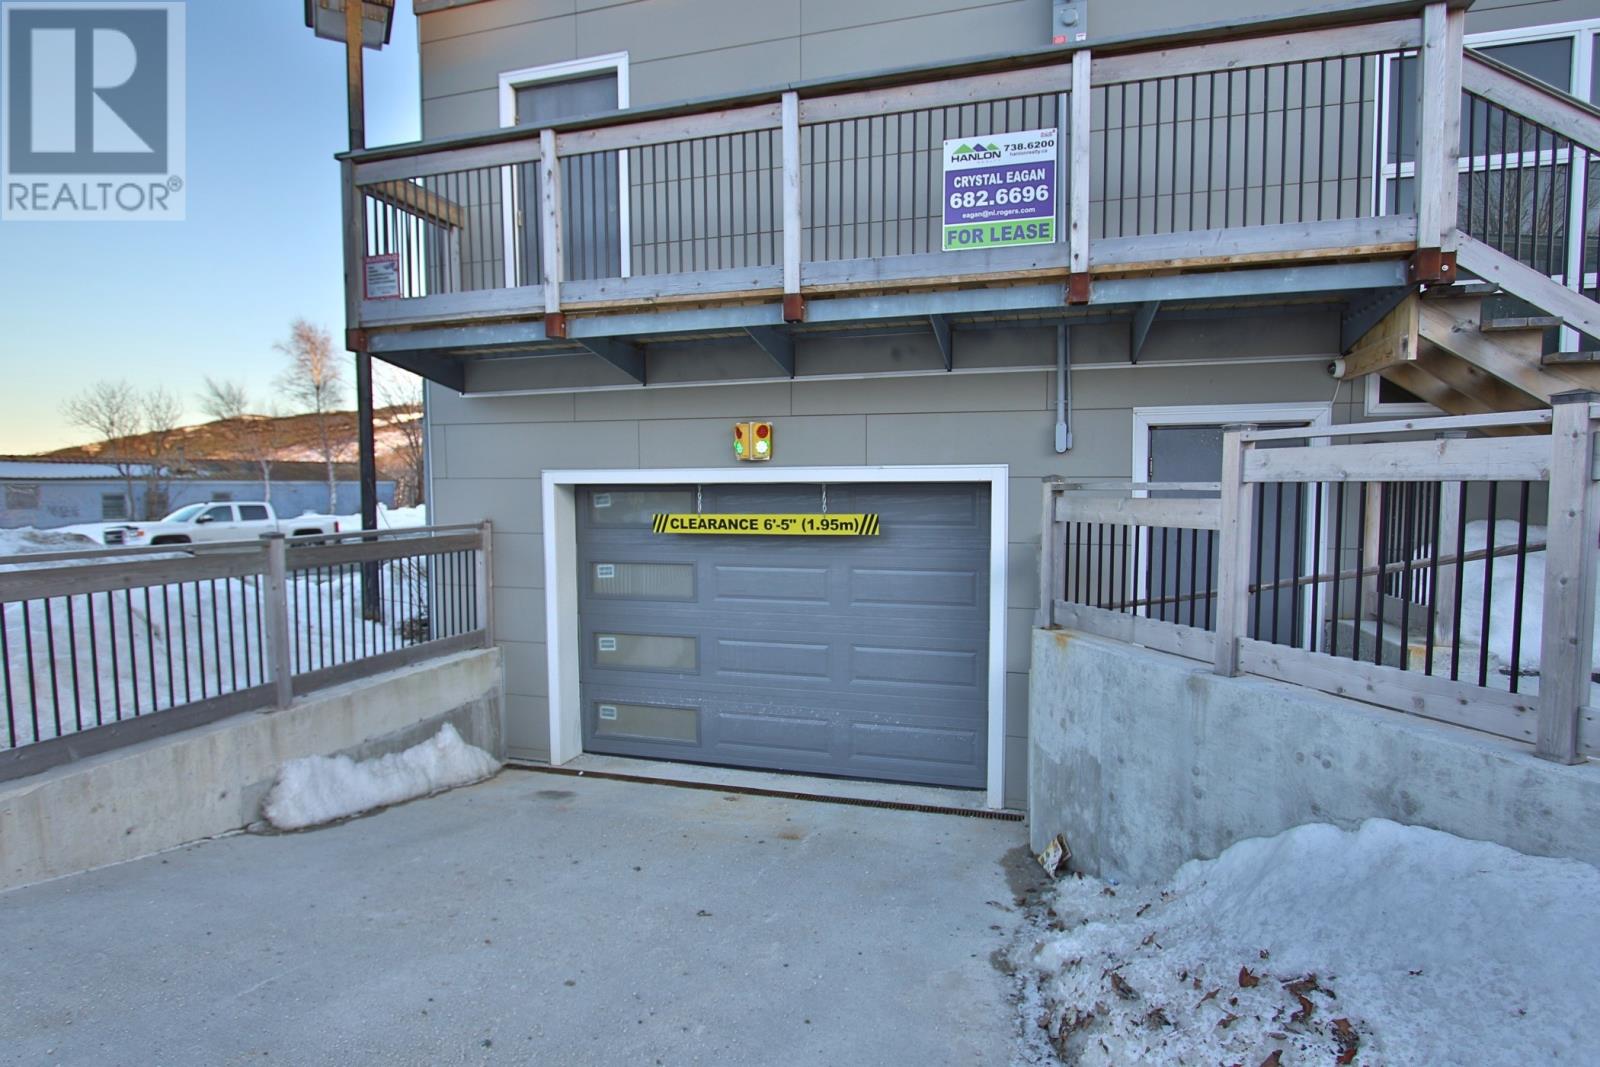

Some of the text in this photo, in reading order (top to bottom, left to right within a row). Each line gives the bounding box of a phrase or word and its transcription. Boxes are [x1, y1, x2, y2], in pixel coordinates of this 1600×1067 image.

[1004, 139, 1055, 152] 738.6200
[951, 151, 1002, 163] HANLON
[953, 168, 1046, 187] CRYSTAL EAGAN
[949, 184, 1049, 209] 682.6696
[946, 222, 1050, 246] FOR LEASE
[669, 517, 759, 531] CLEARANCE
[801, 518, 860, 533] (1.95m)
